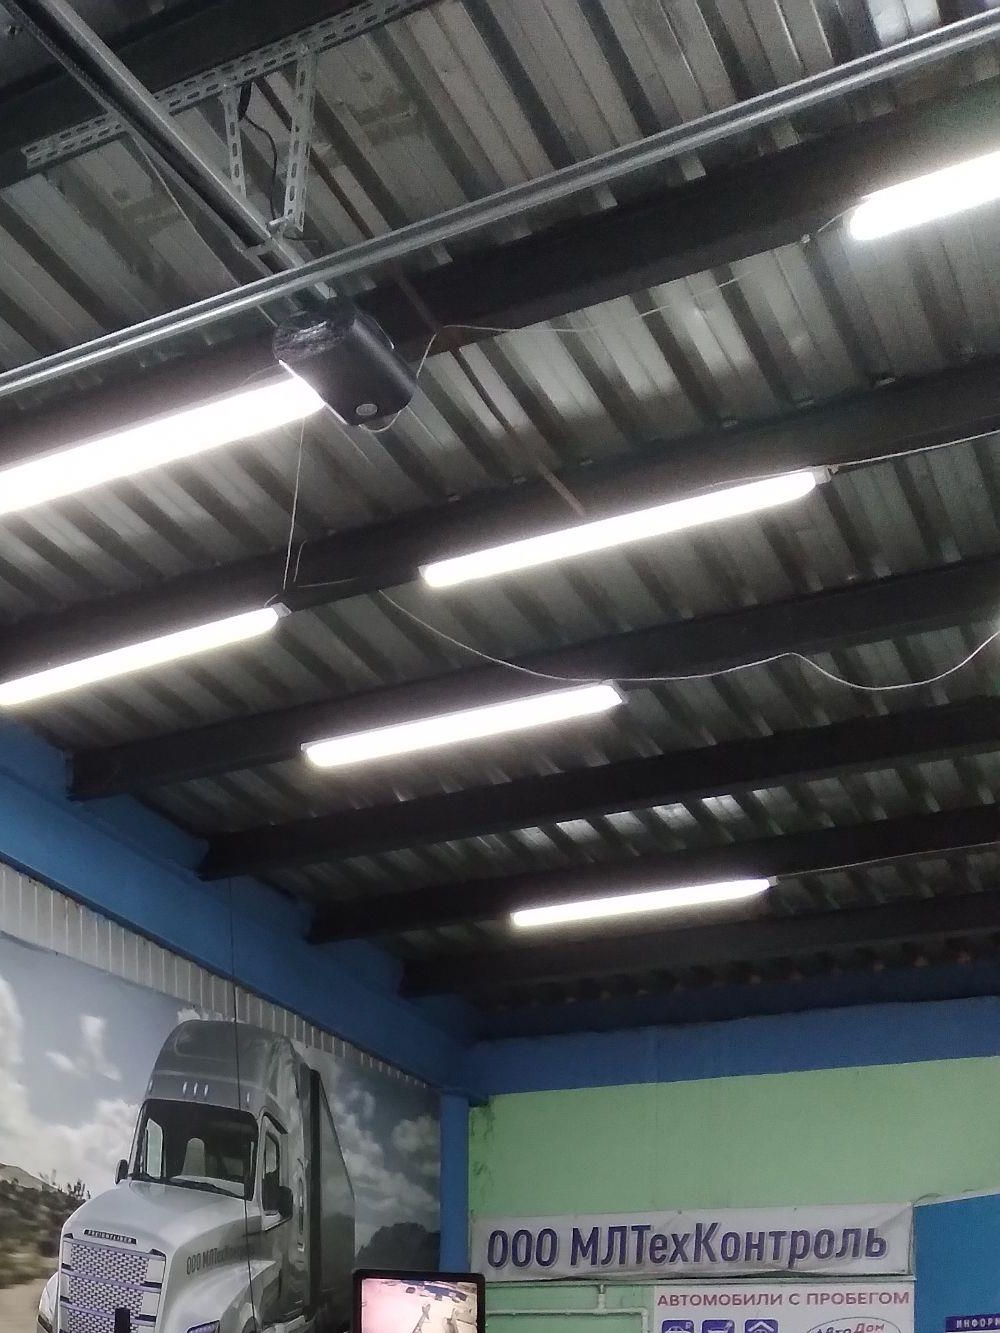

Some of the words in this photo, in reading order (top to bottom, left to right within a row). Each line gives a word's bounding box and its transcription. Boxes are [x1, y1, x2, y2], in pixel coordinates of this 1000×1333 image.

[486, 1228, 559, 1268] ООО
[570, 1222, 888, 1270] МЛТехКонтроль
[657, 1293, 783, 1306] АВТОМОБИЛИ
[788, 1293, 801, 1305] С
[806, 1291, 910, 1305] ПРОБЕГОМ
